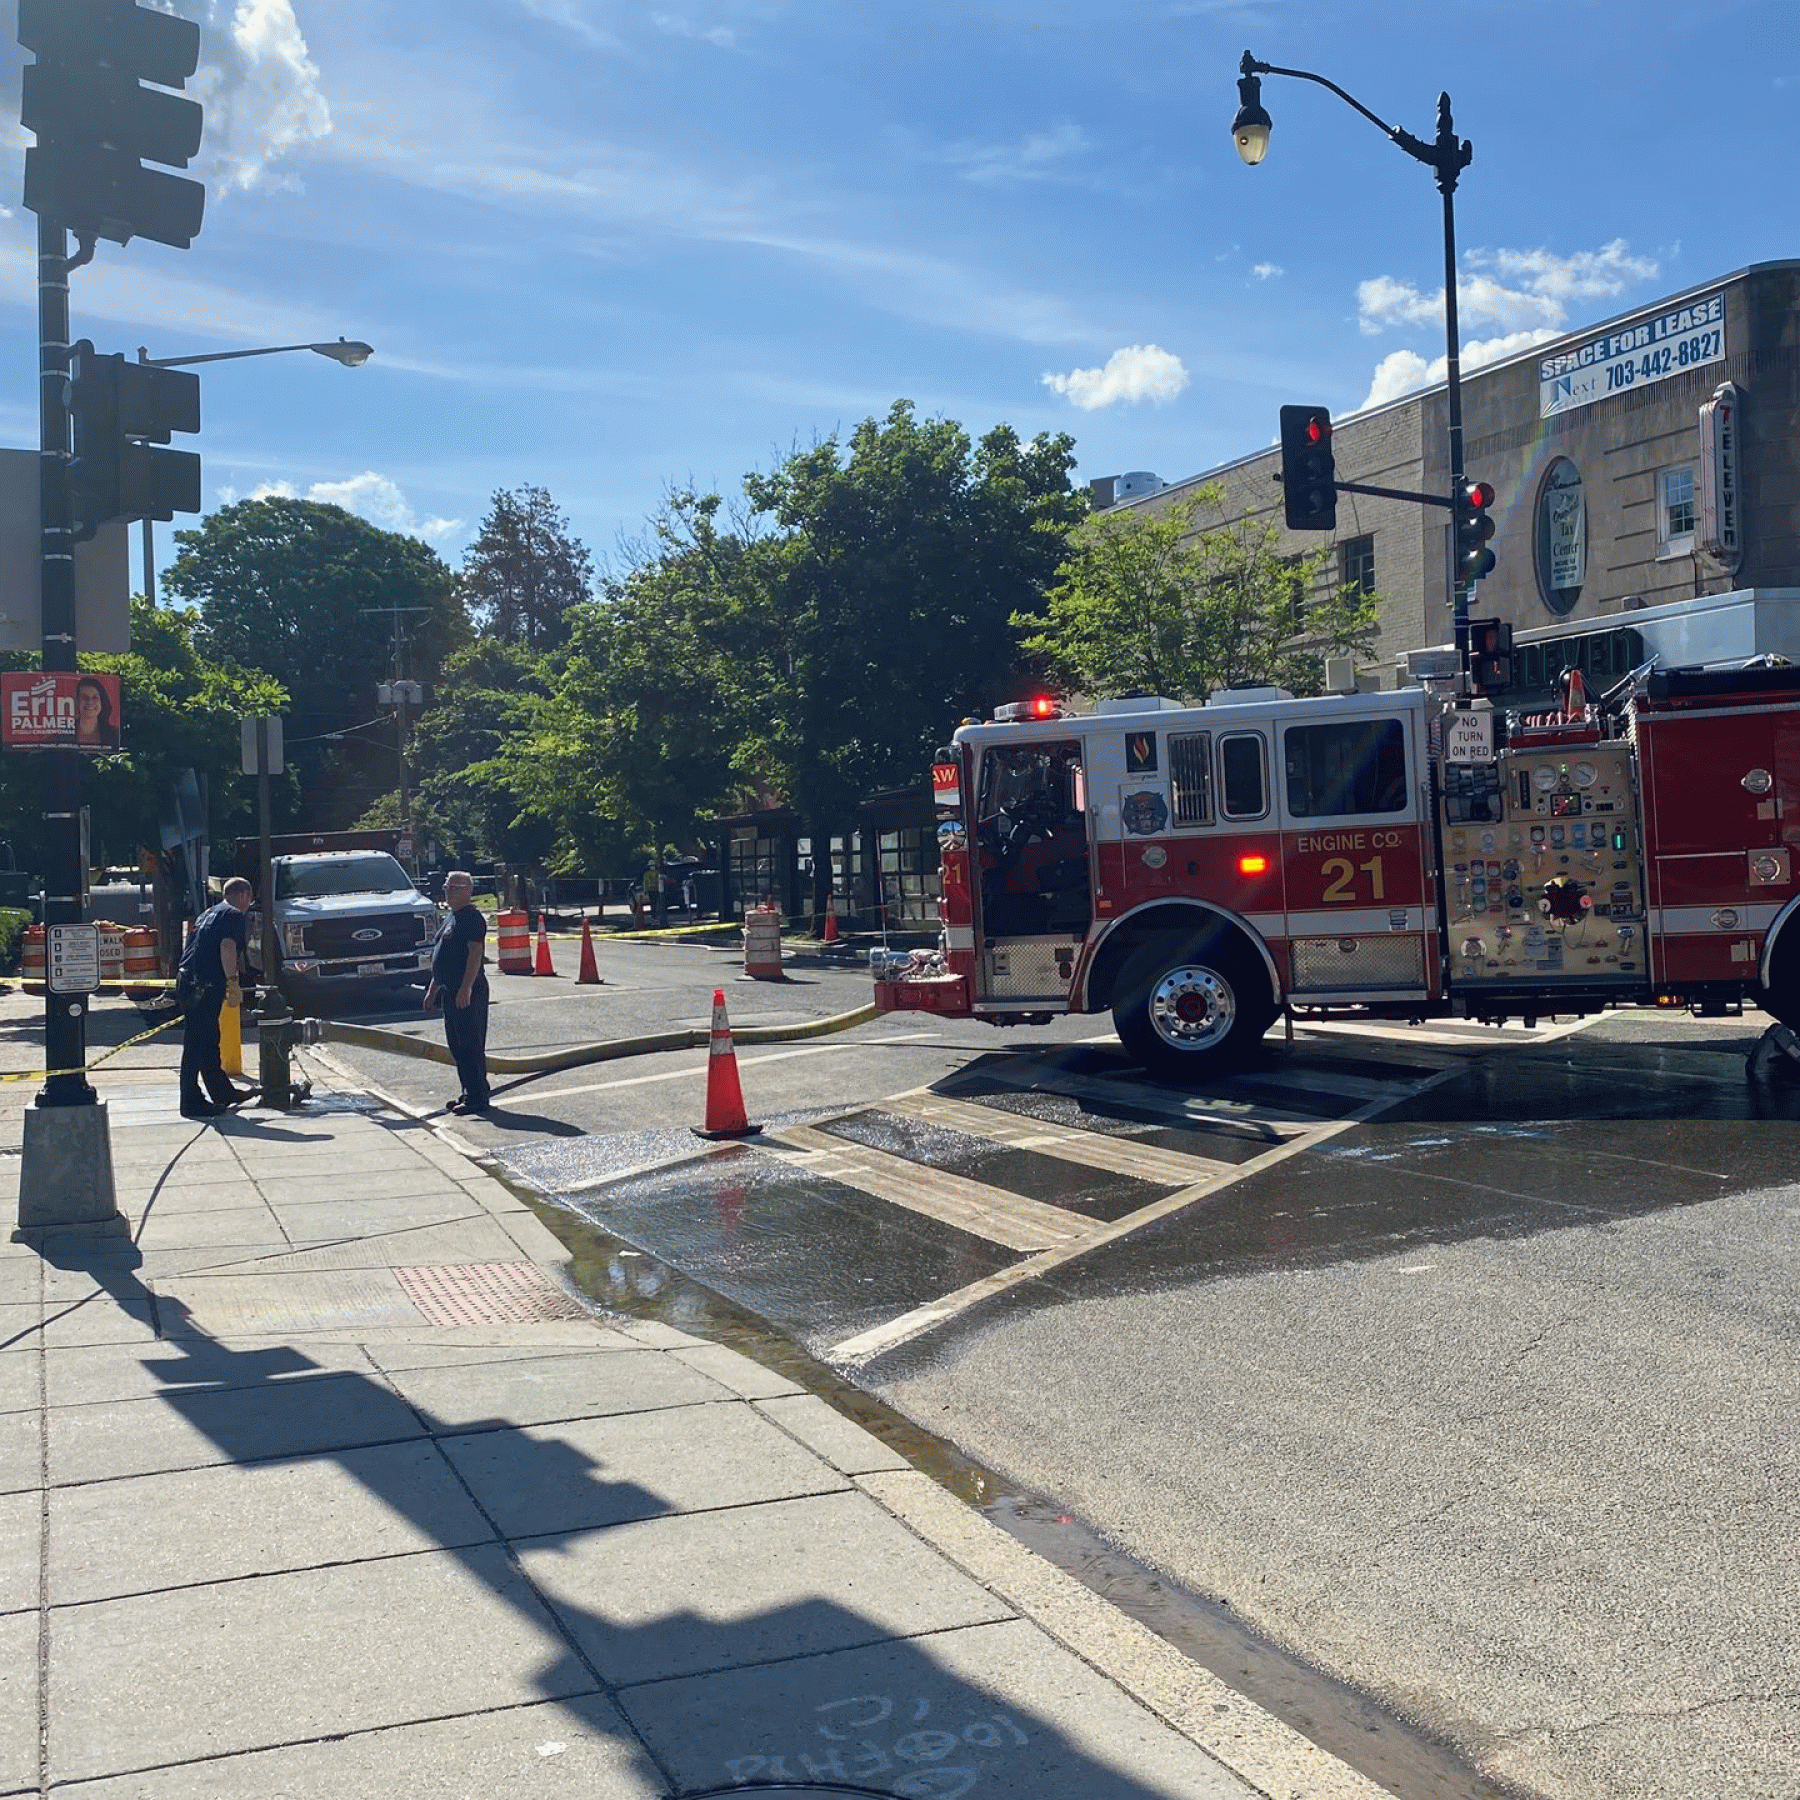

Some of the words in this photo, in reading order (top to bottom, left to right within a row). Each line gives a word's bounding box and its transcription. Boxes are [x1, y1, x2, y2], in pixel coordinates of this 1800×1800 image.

[1541, 339, 1605, 380] SPACE
[1609, 325, 1650, 356] FOR
[1654, 297, 1721, 341] LEASE
[1605, 329, 1721, 391] 703-442-8827
[11, 690, 75, 716] Erin
[11, 717, 76, 729] PALMER
[1462, 716, 1478, 727] NO
[1458, 731, 1484, 742] TURN
[1452, 745, 1467, 756] ON
[1470, 745, 1490, 756] RED
[1298, 833, 1366, 853] ENGINE
[1371, 831, 1402, 849] CO.
[942, 863, 961, 885] 21
[1320, 855, 1385, 902] 21
